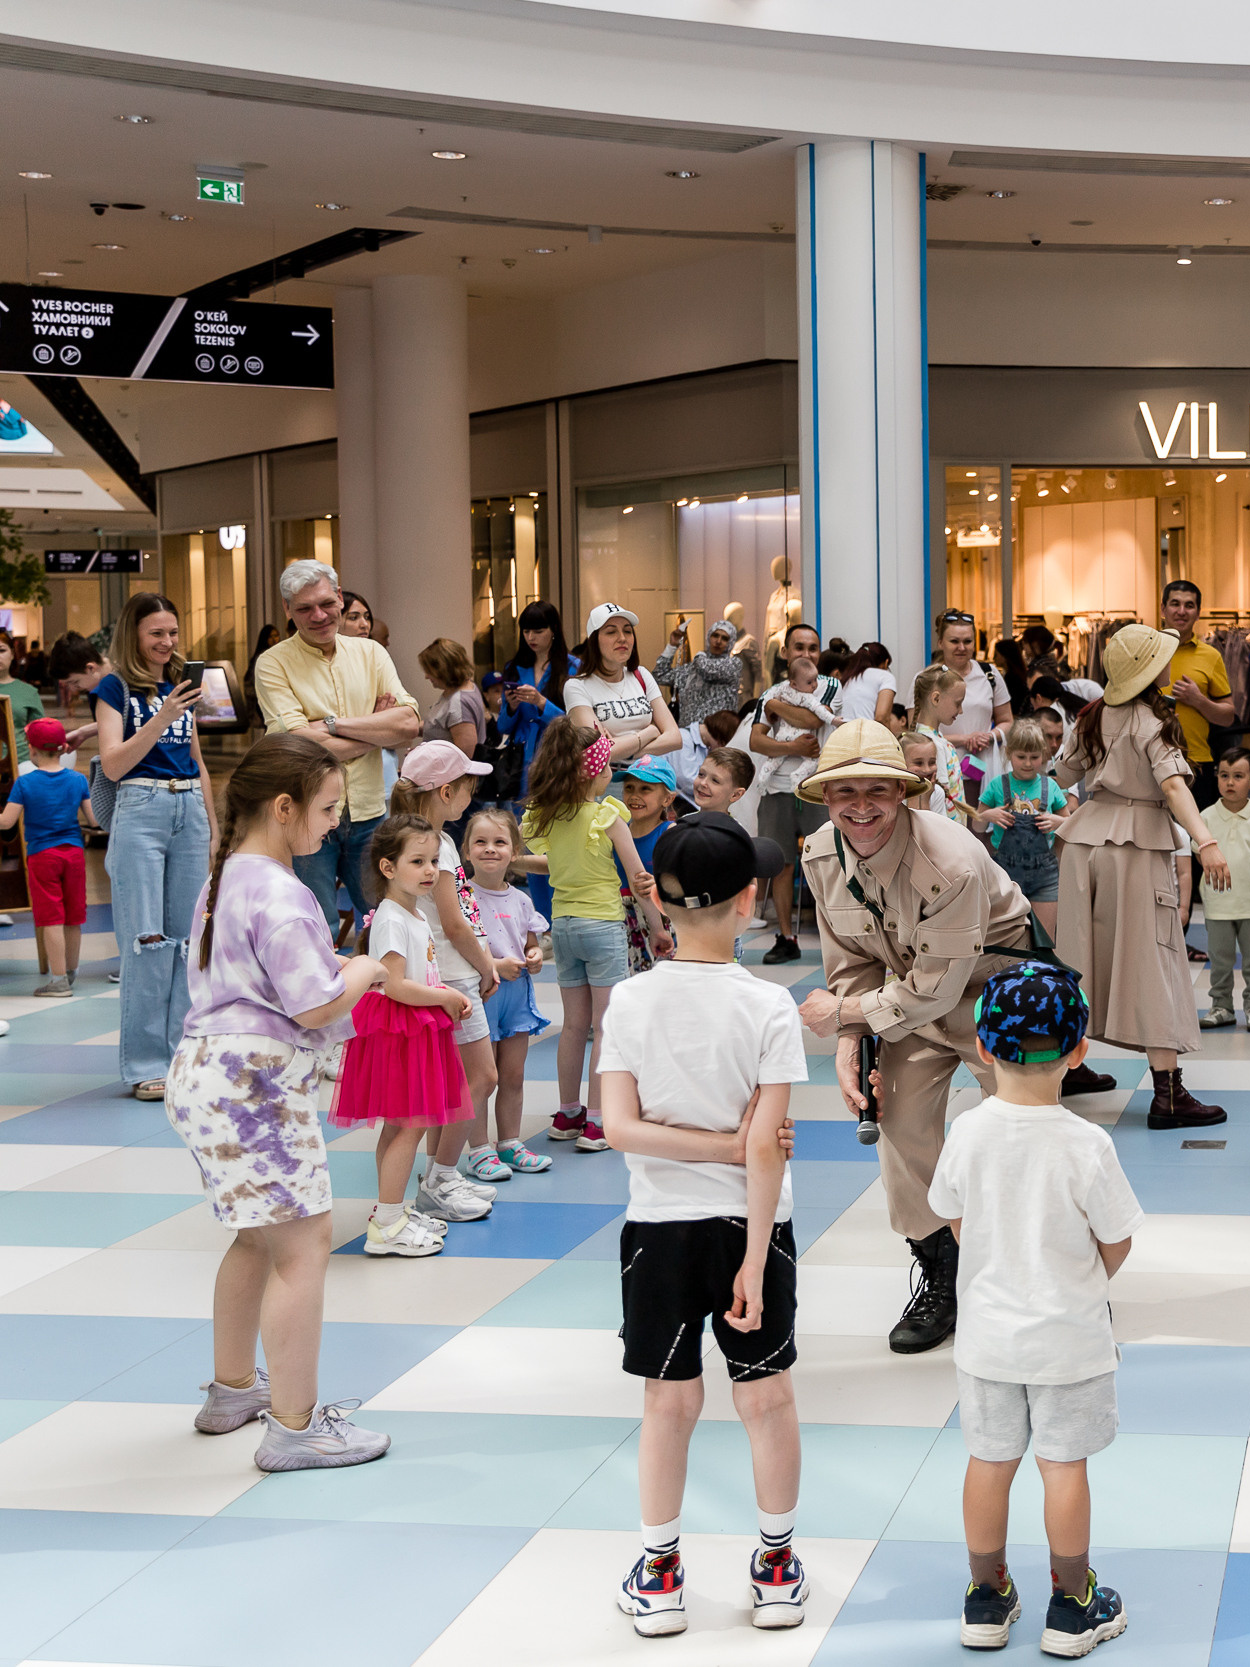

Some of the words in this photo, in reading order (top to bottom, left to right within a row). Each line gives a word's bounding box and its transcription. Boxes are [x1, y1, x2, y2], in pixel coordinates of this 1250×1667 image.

[32, 299, 62, 311] YVES
[64, 301, 114, 314] ROCHER
[31, 311, 111, 326] ХАМОВНИКИ
[33, 324, 80, 337] ТУАЛЕТ
[194, 322, 247, 335] SOKOLOV
[194, 335, 235, 347] TEZENIS
